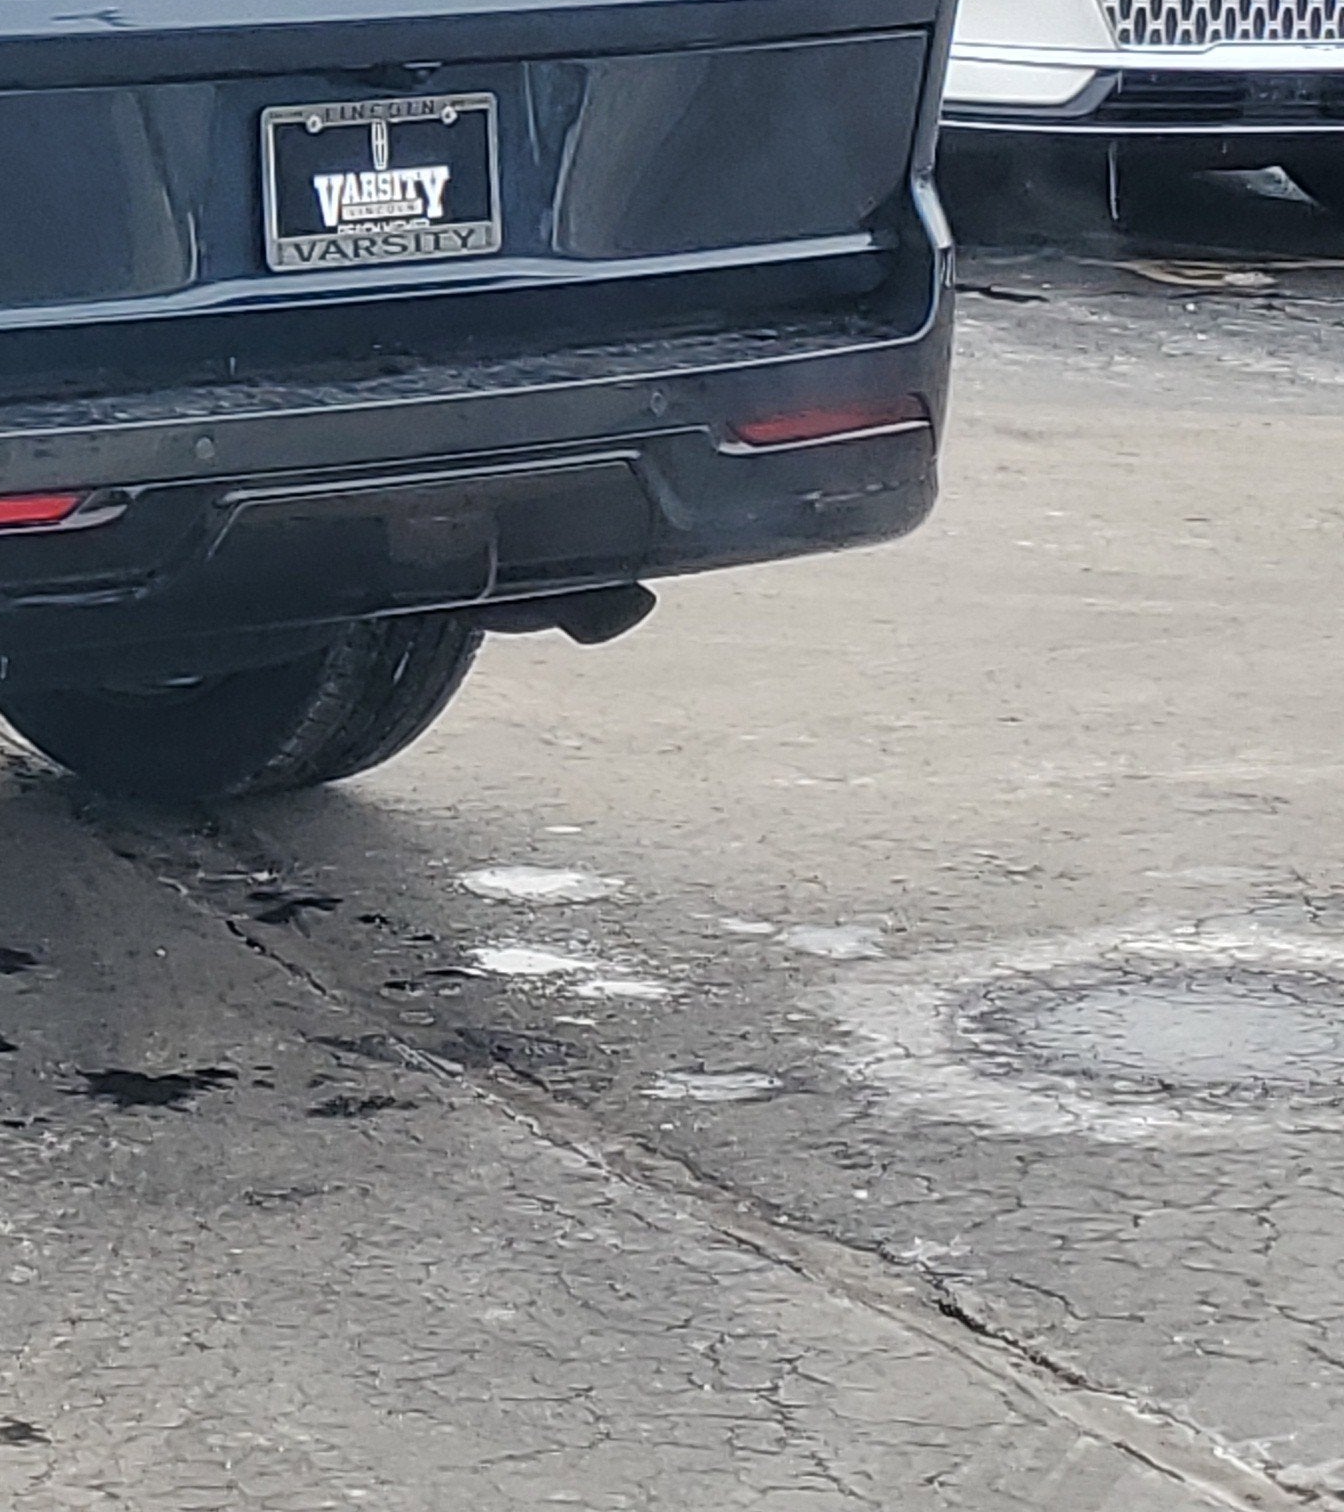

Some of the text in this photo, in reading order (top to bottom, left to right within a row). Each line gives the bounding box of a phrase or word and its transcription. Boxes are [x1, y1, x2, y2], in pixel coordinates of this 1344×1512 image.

[324, 99, 435, 123] LINCOLN
[313, 165, 450, 227] VARSITY
[293, 228, 476, 263] VARSITY
